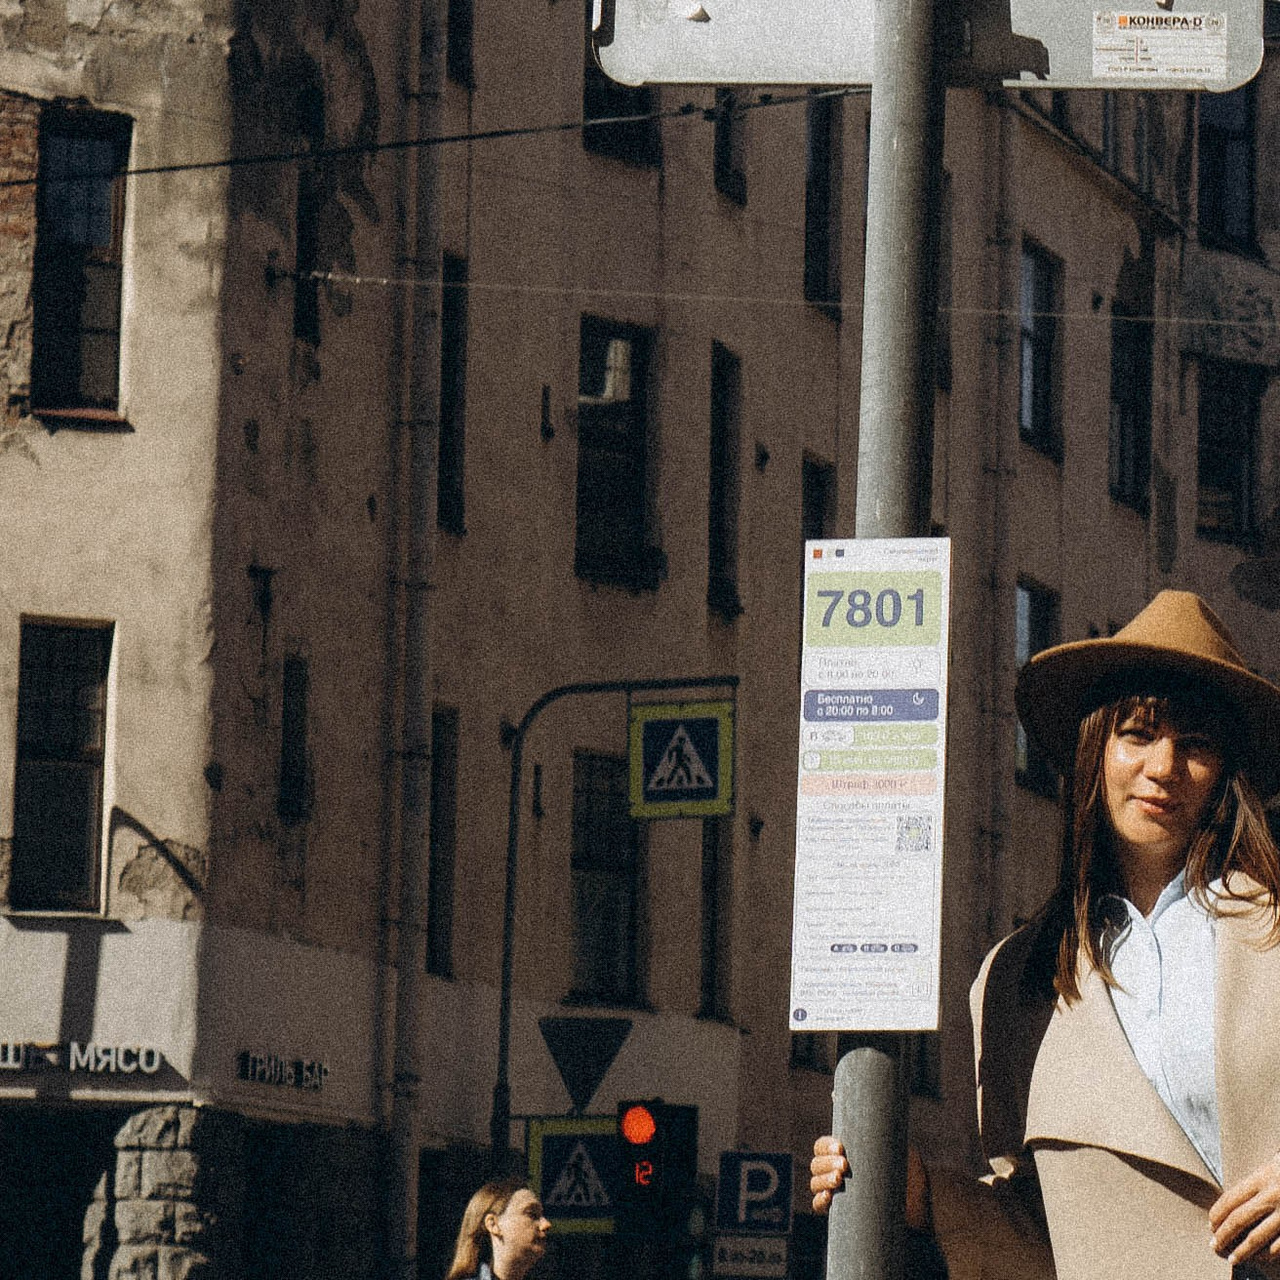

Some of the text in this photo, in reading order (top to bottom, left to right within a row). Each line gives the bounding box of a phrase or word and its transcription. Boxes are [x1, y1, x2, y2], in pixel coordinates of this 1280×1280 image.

[817, 589, 924, 628] 7801
[818, 694, 873, 705] Бесплатно
[825, 706, 853, 716] 20:00
[856, 708, 869, 716] по
[70, 1041, 161, 1073] МЯСО
